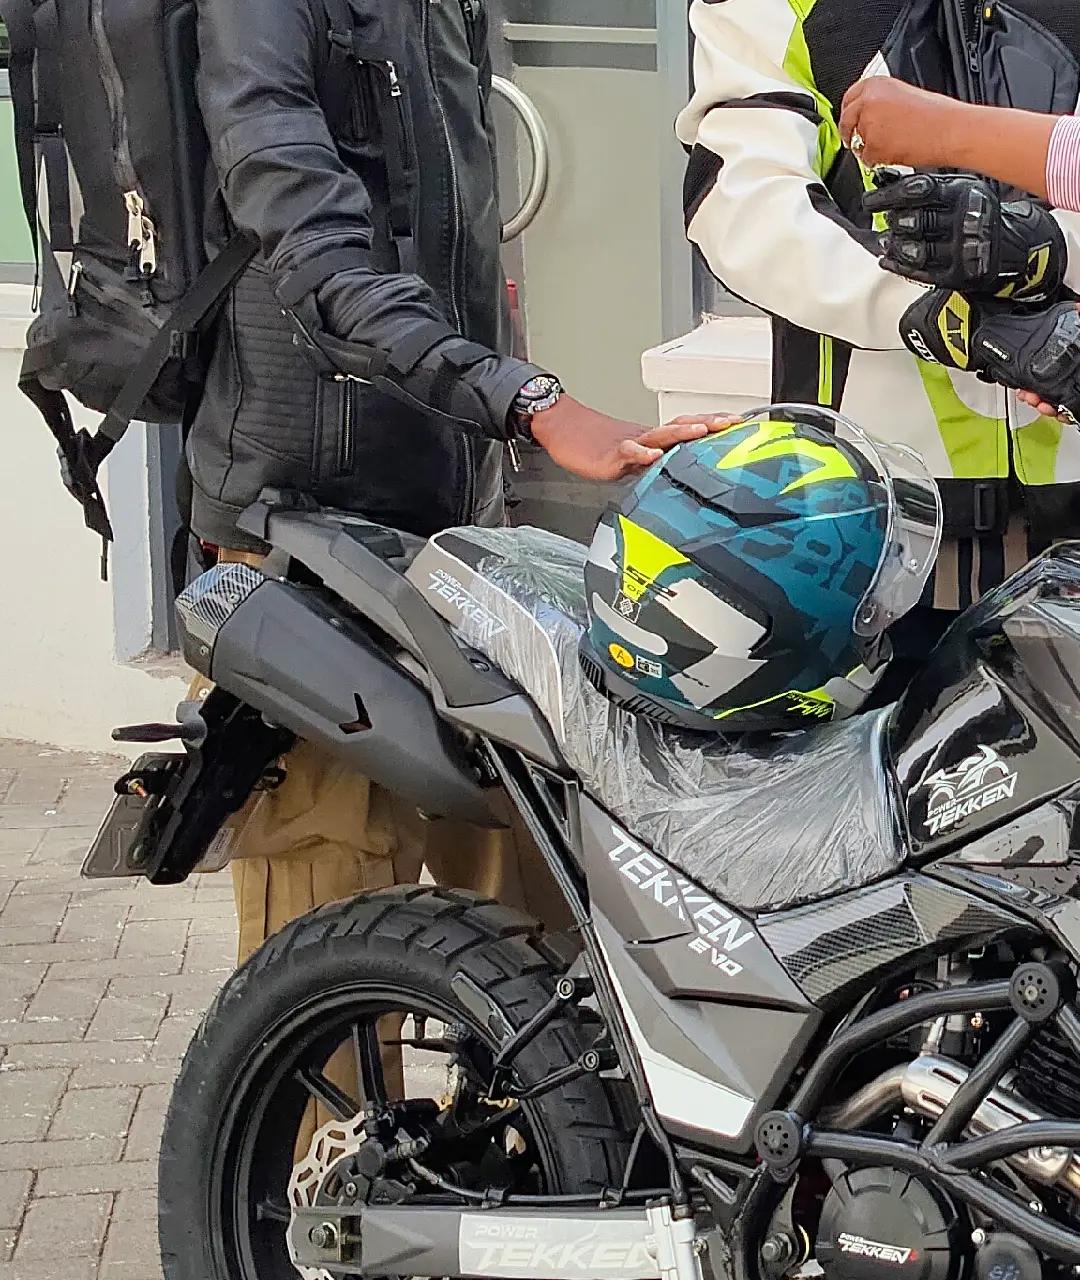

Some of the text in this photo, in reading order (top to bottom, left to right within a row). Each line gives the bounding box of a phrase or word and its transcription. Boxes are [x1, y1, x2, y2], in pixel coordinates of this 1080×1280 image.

[428, 573, 507, 637] TEKKEN
[923, 772, 1018, 835] TEKKEN
[927, 799, 957, 818] POWER
[608, 825, 755, 951] TEKKEN
[688, 936, 743, 976] EVO
[474, 1223, 537, 1239] POWER
[838, 1238, 912, 1264] TEKKEN
